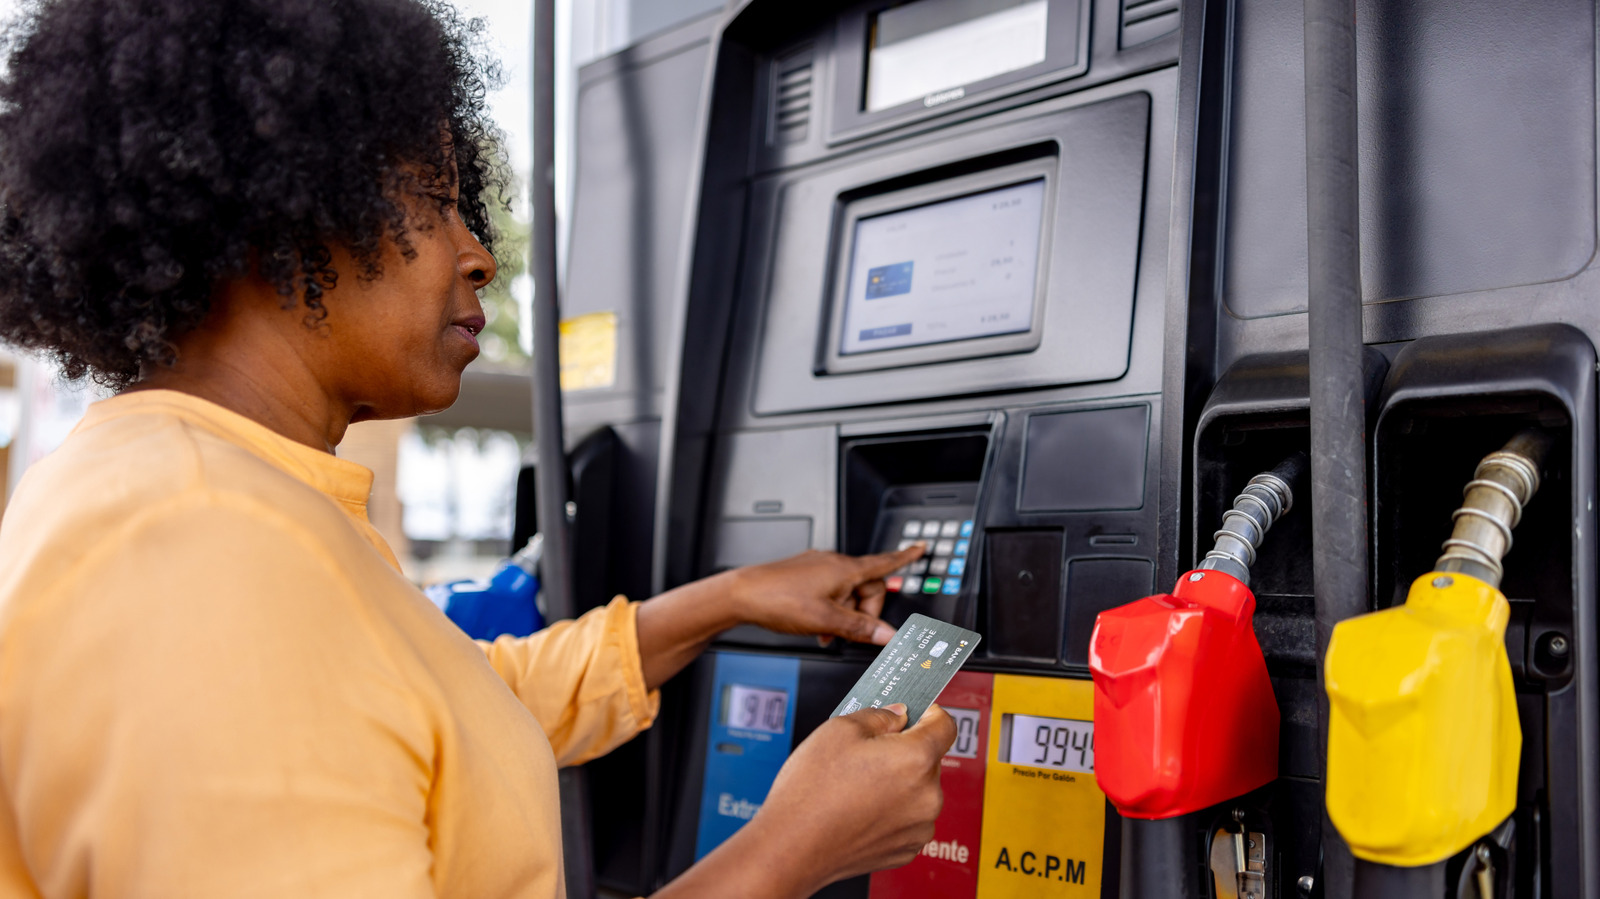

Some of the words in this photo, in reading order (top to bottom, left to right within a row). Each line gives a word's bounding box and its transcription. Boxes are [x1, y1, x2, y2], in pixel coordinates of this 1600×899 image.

[903, 623, 918, 640] JUAN
[918, 629, 937, 650] 3400
[872, 648, 899, 679] MARTINEZ
[900, 652, 919, 673] 7655
[945, 647, 963, 666] BANK
[881, 675, 901, 697] 1100
[1013, 767, 1036, 778] Precio
[1038, 770, 1051, 779] Por
[1052, 772, 1076, 783] Galón
[994, 847, 1087, 885] A.C.P.M
